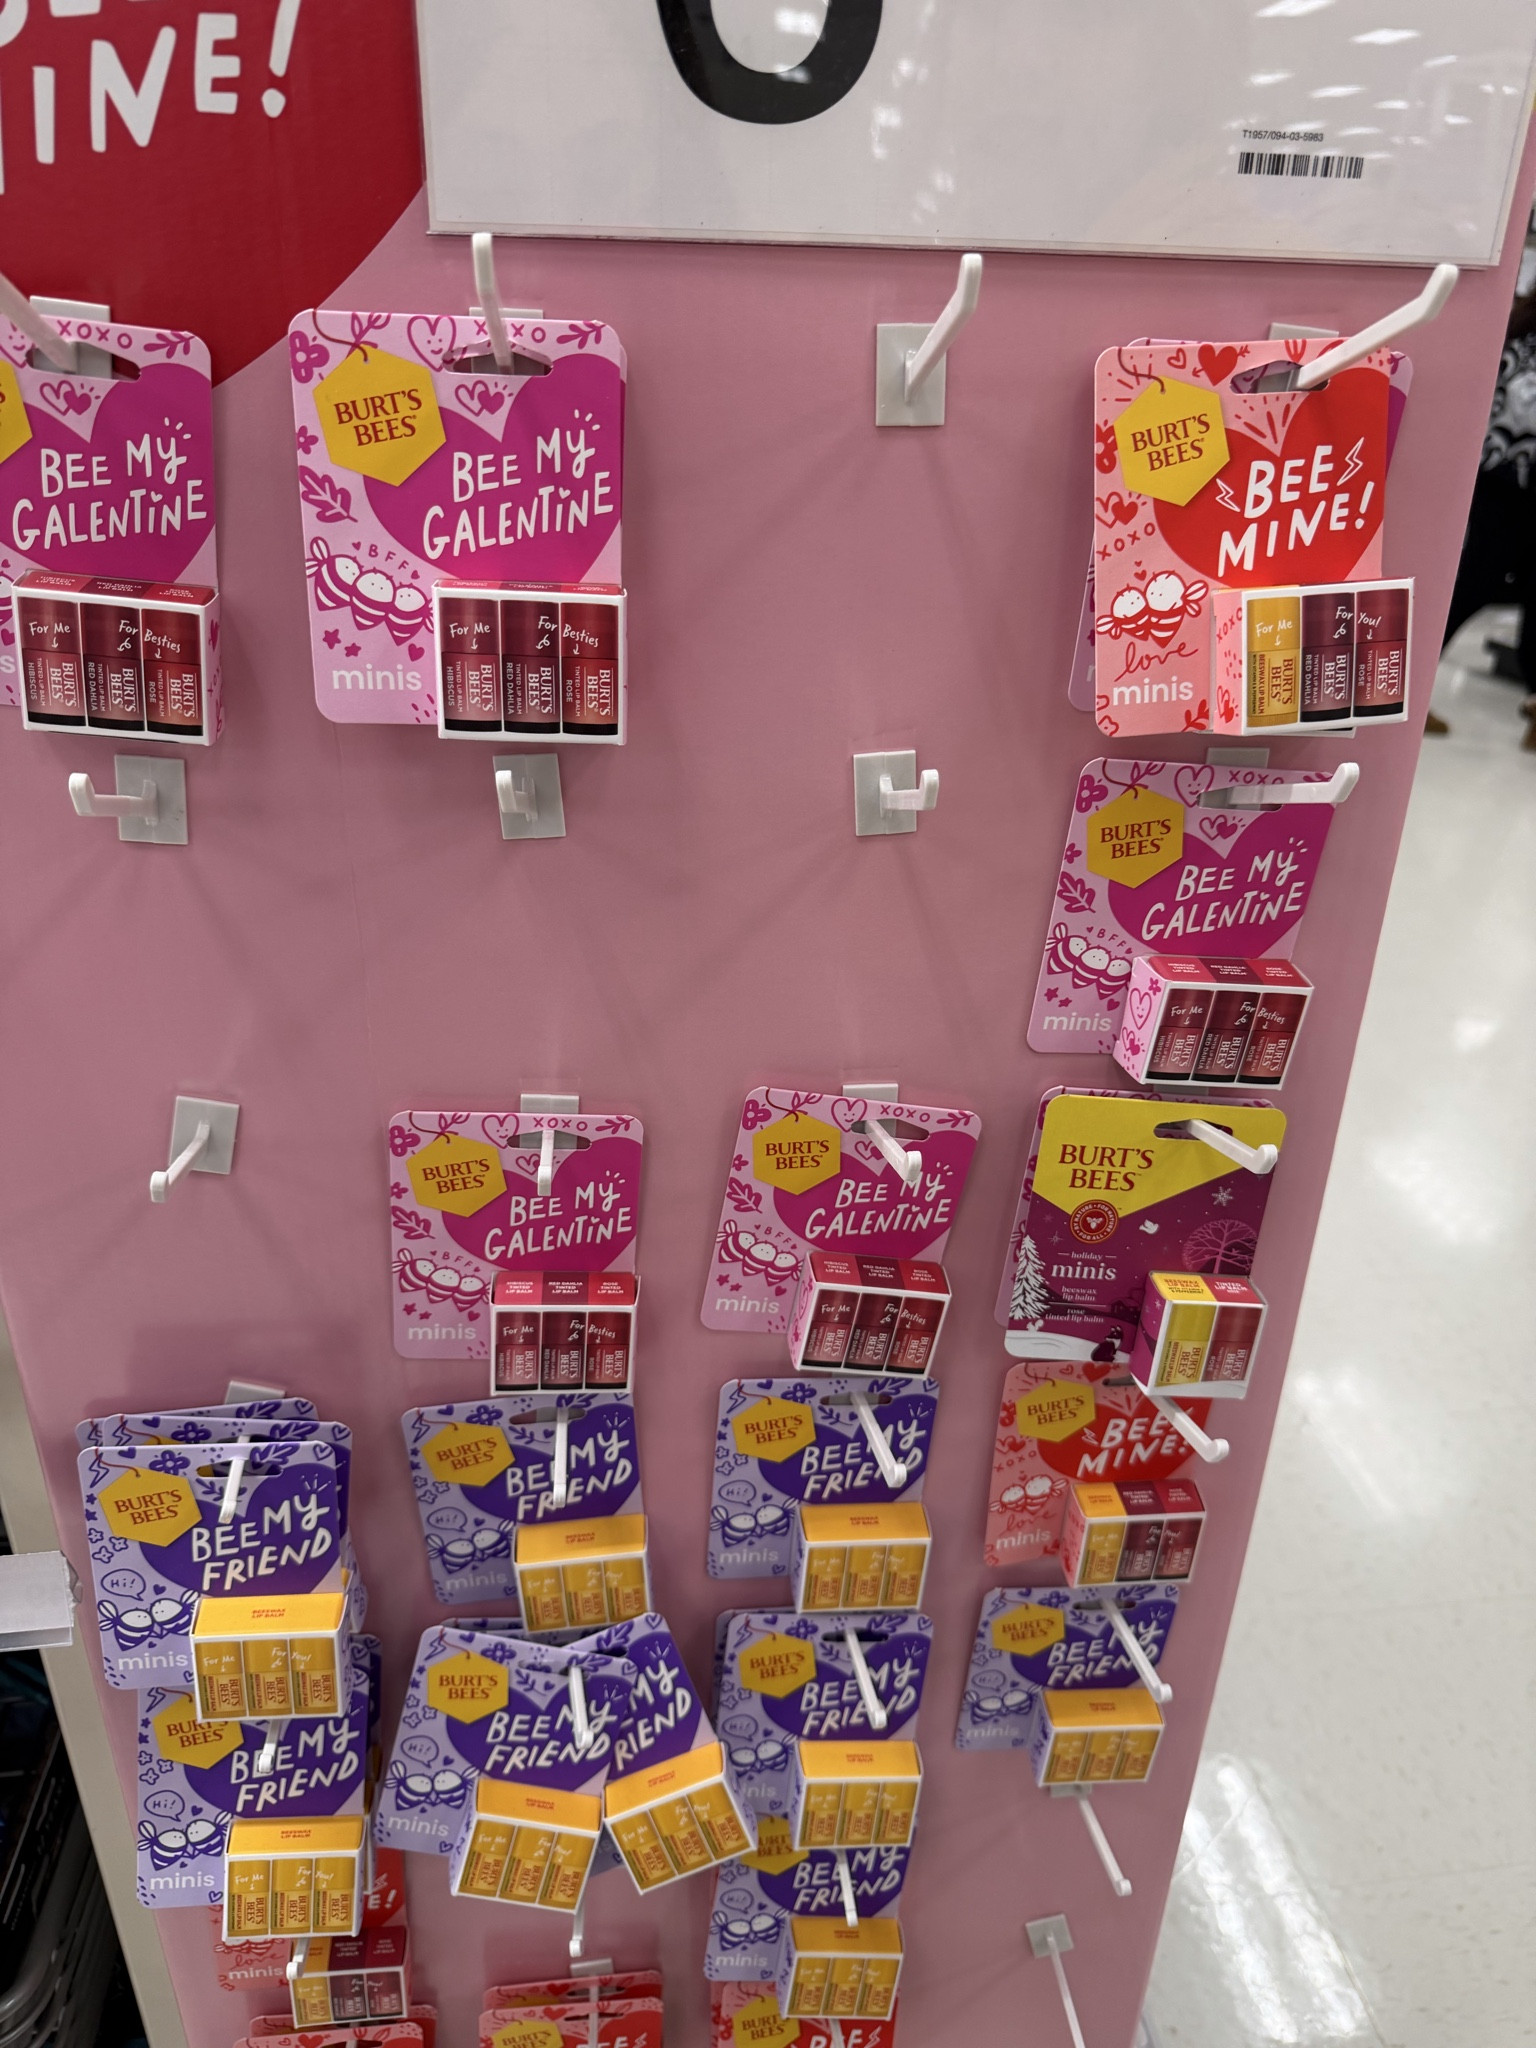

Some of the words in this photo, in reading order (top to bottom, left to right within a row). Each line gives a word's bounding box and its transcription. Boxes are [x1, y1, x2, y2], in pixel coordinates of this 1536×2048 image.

[0, 0, 300, 195] INE!
[334, 389, 423, 424] BURT'S
[1130, 413, 1210, 452] BURT'S
[41, 449, 112, 497] BEE
[452, 452, 522, 502] BEE
[1244, 445, 1333, 519] BEE
[1218, 481, 1374, 577] MINE!
[29, 622, 48, 636] For
[54, 622, 70, 634] Me
[1256, 622, 1273, 637] For
[1277, 620, 1293, 631] Me
[1335, 606, 1353, 621] For
[1358, 612, 1381, 628] You!
[119, 620, 138, 636] For
[144, 628, 181, 653] Besties
[449, 624, 469, 638] For
[473, 623, 491, 634] Me
[538, 616, 557, 632] For
[562, 624, 599, 647] Besties
[1114, 641, 1199, 682] love
[1388, 651, 1400, 695] BURT'S
[28, 662, 37, 699] HIBISCUS
[62, 662, 76, 706] BURT'S
[122, 668, 136, 712] BURT'S
[332, 664, 422, 692] minis
[481, 664, 493, 711] BURT'S
[540, 667, 552, 713] BURT'S
[1282, 658, 1293, 704] BURT'S
[1335, 655, 1347, 699] BURT'S
[89, 681, 98, 711] DAHLIA
[182, 674, 195, 717] BURT'S
[600, 670, 610, 715] BURT'S
[1113, 676, 1194, 706] minis
[1100, 819, 1172, 844] BURT'S
[1175, 865, 1235, 902] BEE
[1043, 1012, 1112, 1032] minis
[1257, 1008, 1285, 1024] Besties
[765, 1140, 830, 1156] BURT'S
[1059, 1144, 1154, 1169] BURT'S
[422, 1159, 490, 1181] BURT'S
[1069, 1168, 1136, 1191] BEES
[835, 1179, 888, 1208] BEE
[510, 1196, 563, 1227] BEE
[1072, 1251, 1102, 1261] holiday
[1051, 1262, 1117, 1280] minis
[715, 1296, 780, 1314] minis
[901, 1310, 926, 1325] Besties
[408, 1324, 476, 1340] minis
[588, 1324, 616, 1338] Besties
[1027, 1395, 1085, 1416] BURT'S
[744, 1415, 803, 1434] BURT'S
[436, 1437, 498, 1461] BURT'S
[801, 1442, 861, 1475] BEE
[114, 1490, 182, 1512] BURT'S
[191, 1521, 261, 1562] BEE
[996, 1528, 1051, 1549] minis
[202, 1527, 332, 1591] FRIEND
[720, 1549, 779, 1563] minis
[110, 1578, 136, 1589] Hi!
[118, 1652, 188, 1671] minis
[750, 1651, 806, 1669] BURT'S
[1047, 1639, 1103, 1667] BEE
[438, 1674, 498, 1687] BURT'S
[179, 1730, 224, 1748] BEES
[486, 1710, 551, 1744] BEE
[485, 1732, 611, 1776] FRIEND
[236, 1751, 359, 1812] FRIEND
[152, 1800, 176, 1810] Hi!
[388, 1815, 449, 1838] minis
[150, 1872, 215, 1890] minis
[229, 1966, 284, 1980] minis
[715, 1953, 768, 1967] minis
